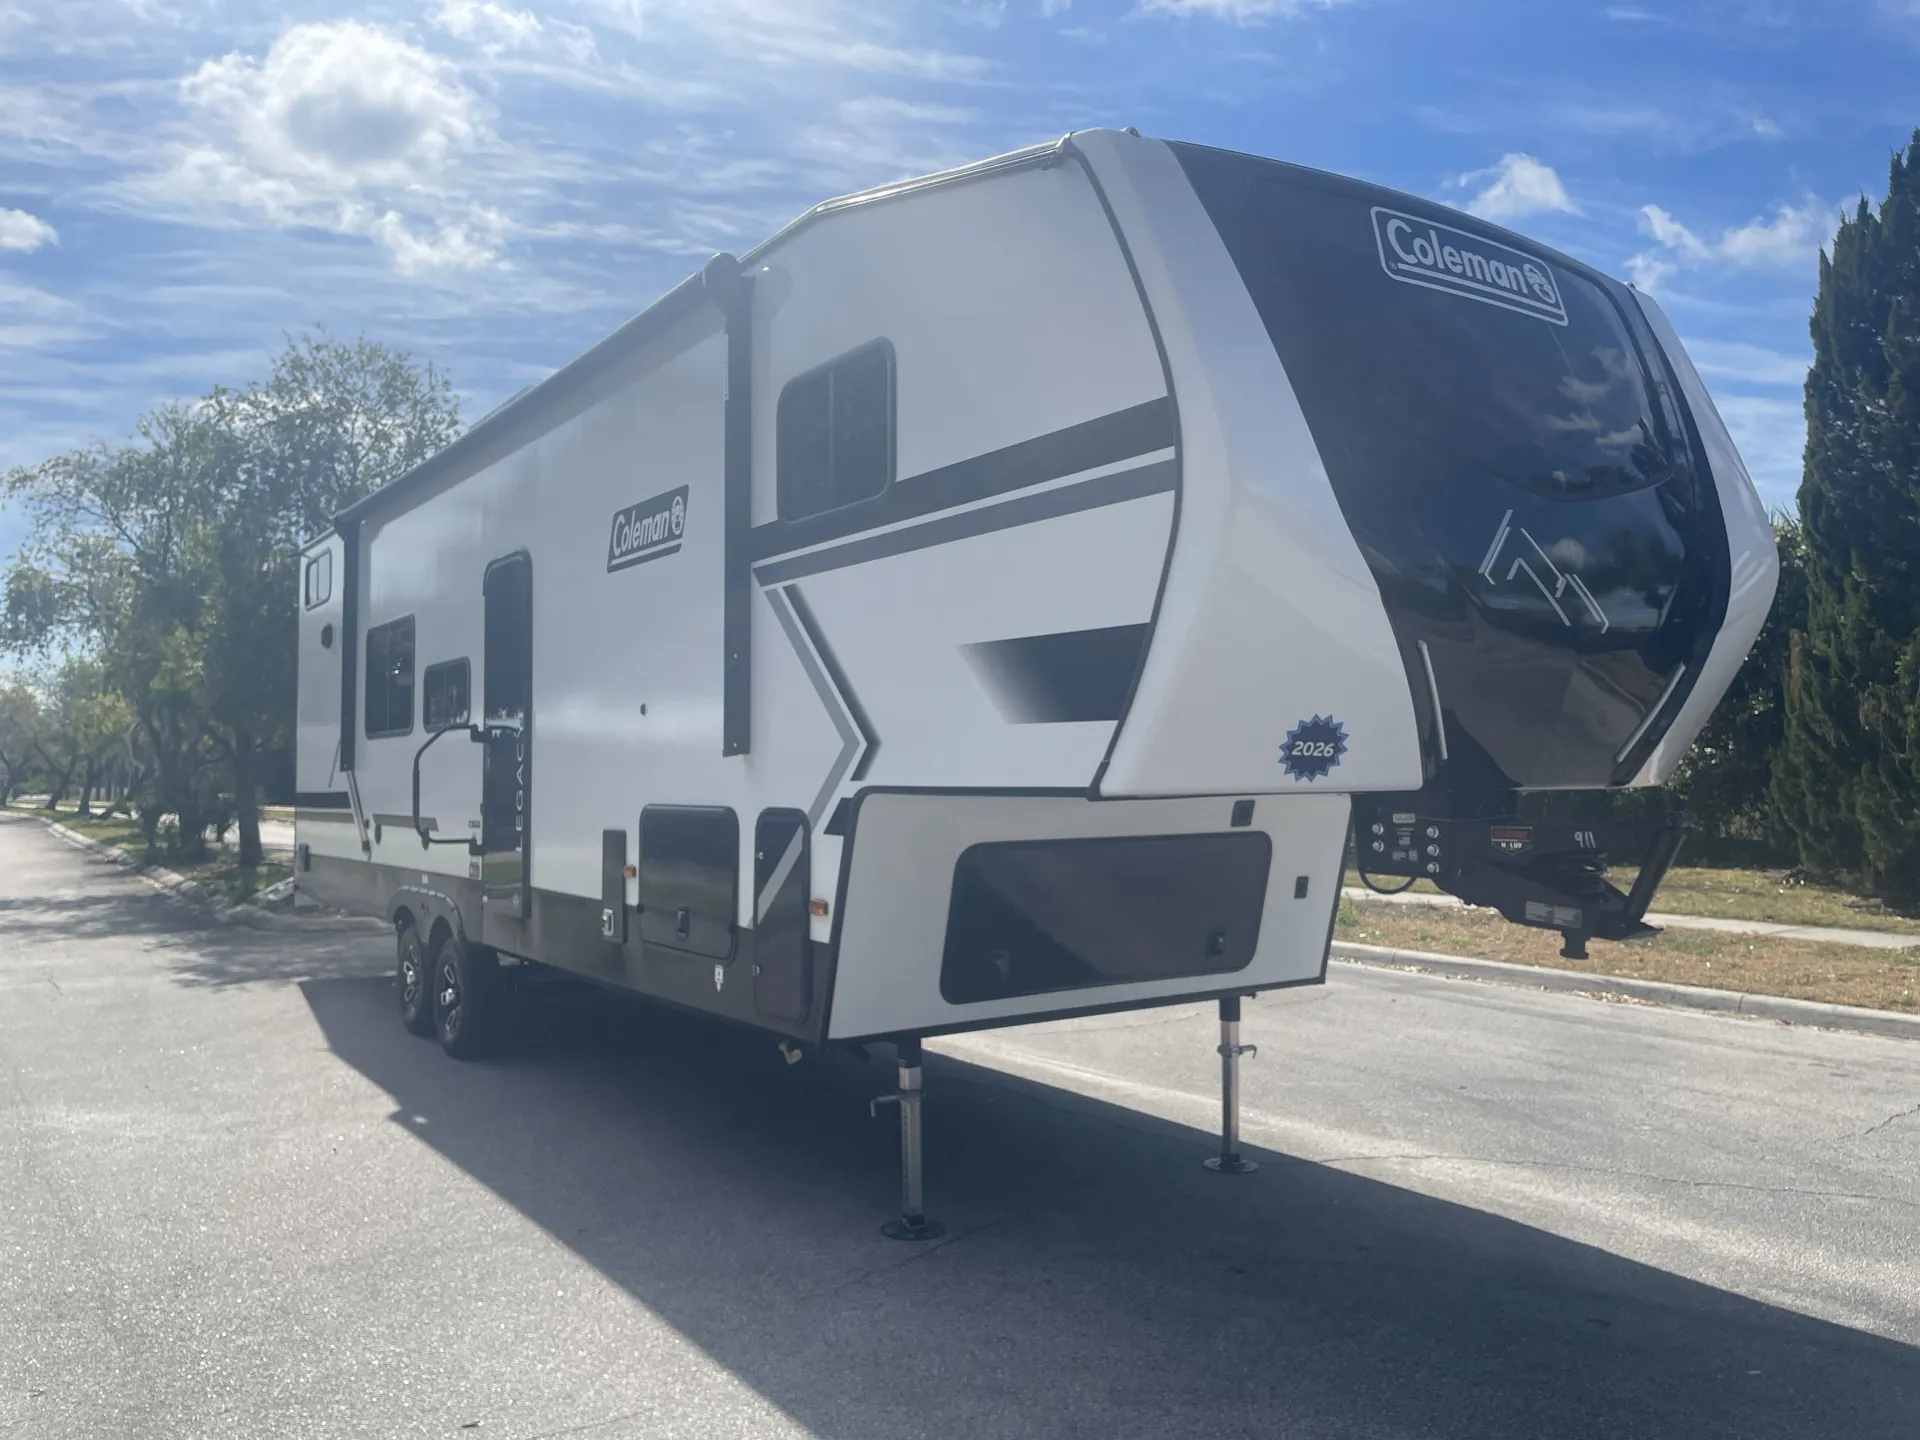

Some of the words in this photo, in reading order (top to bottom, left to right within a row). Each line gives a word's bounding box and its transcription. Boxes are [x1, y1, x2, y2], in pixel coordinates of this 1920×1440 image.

[1386, 218, 1529, 294] Coleman
[613, 510, 670, 557] Coleman
[1291, 740, 1334, 757] 2026
